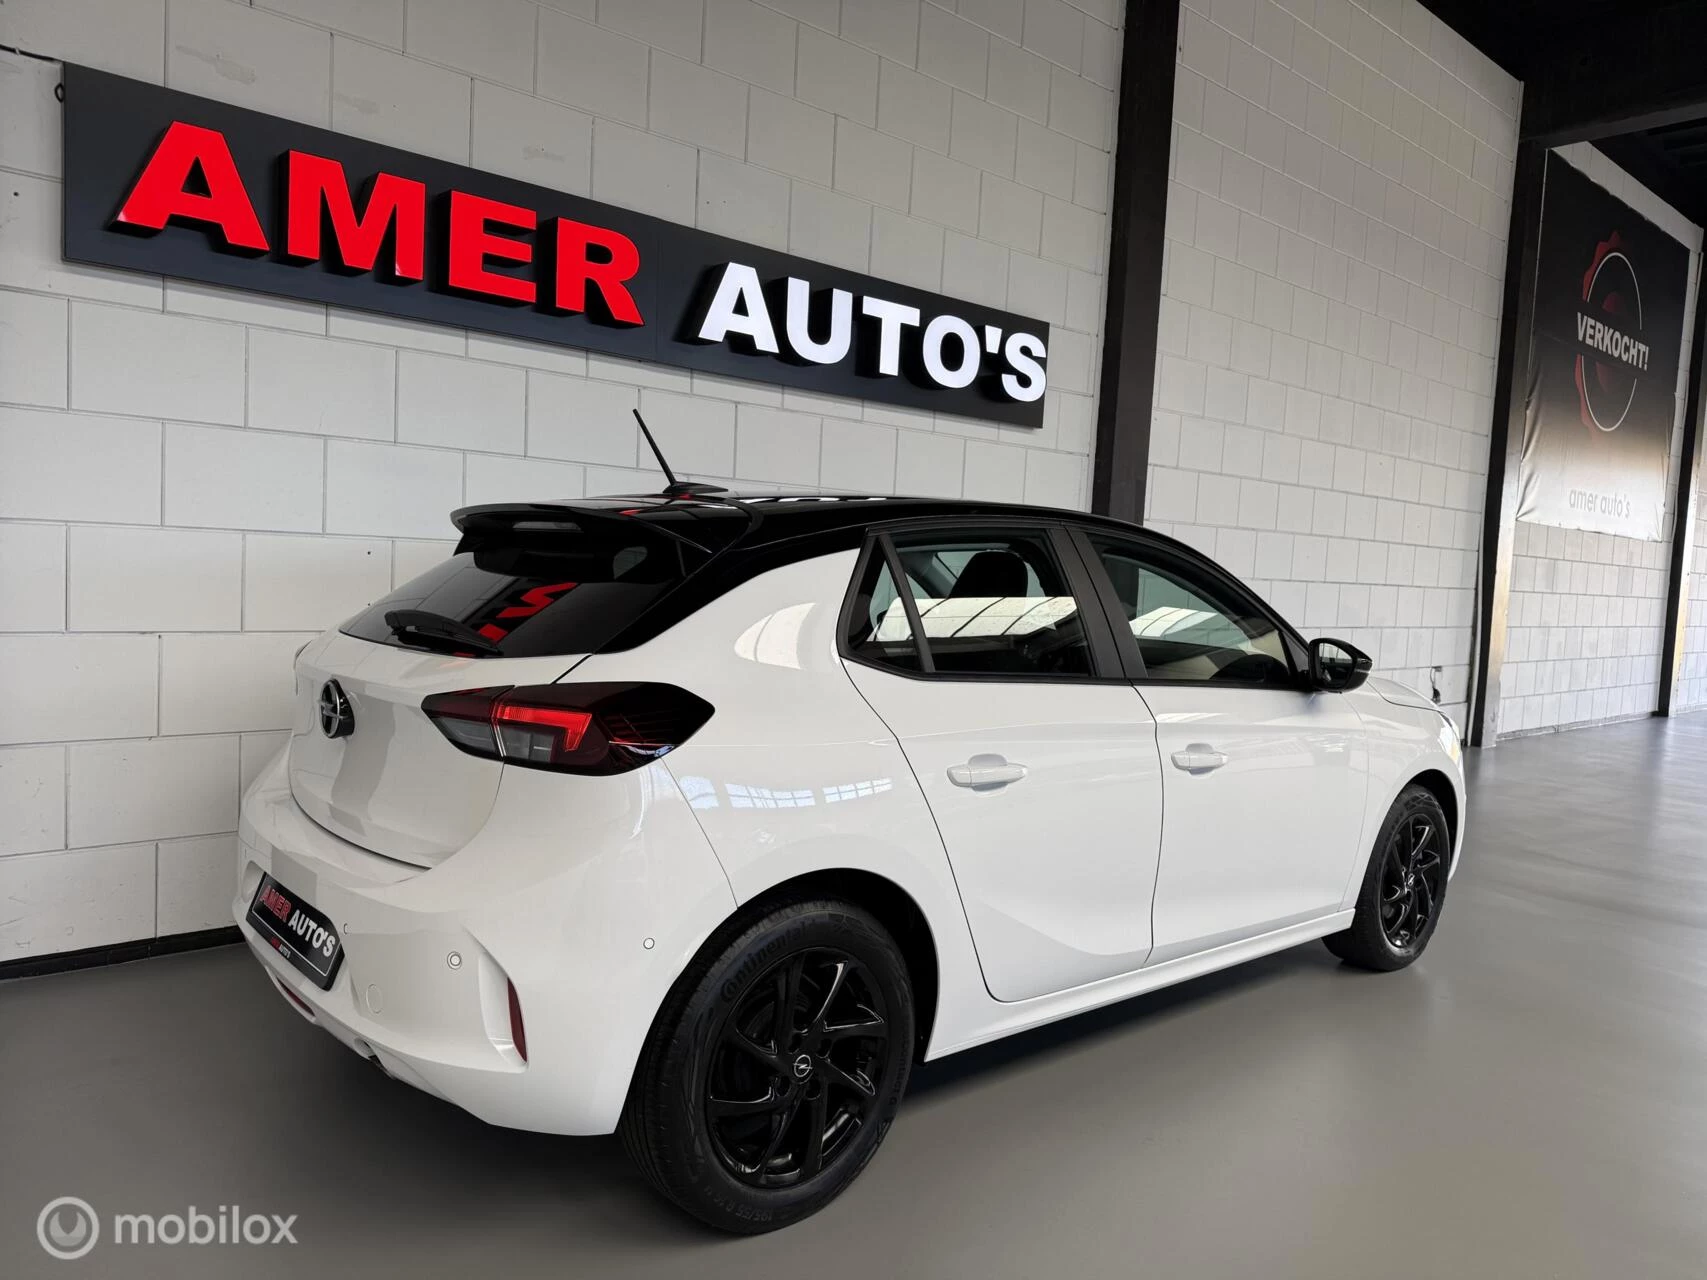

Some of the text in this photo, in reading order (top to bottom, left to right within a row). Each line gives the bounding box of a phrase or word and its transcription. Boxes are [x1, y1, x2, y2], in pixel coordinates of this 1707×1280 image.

[113, 120, 1047, 402] AMER AUTO'S
[1577, 312, 1649, 371] VERKOCHT!
[1569, 490, 1630, 518] amer auto's
[260, 885, 291, 923] AMER
[288, 909, 336, 957] AUTO'S
